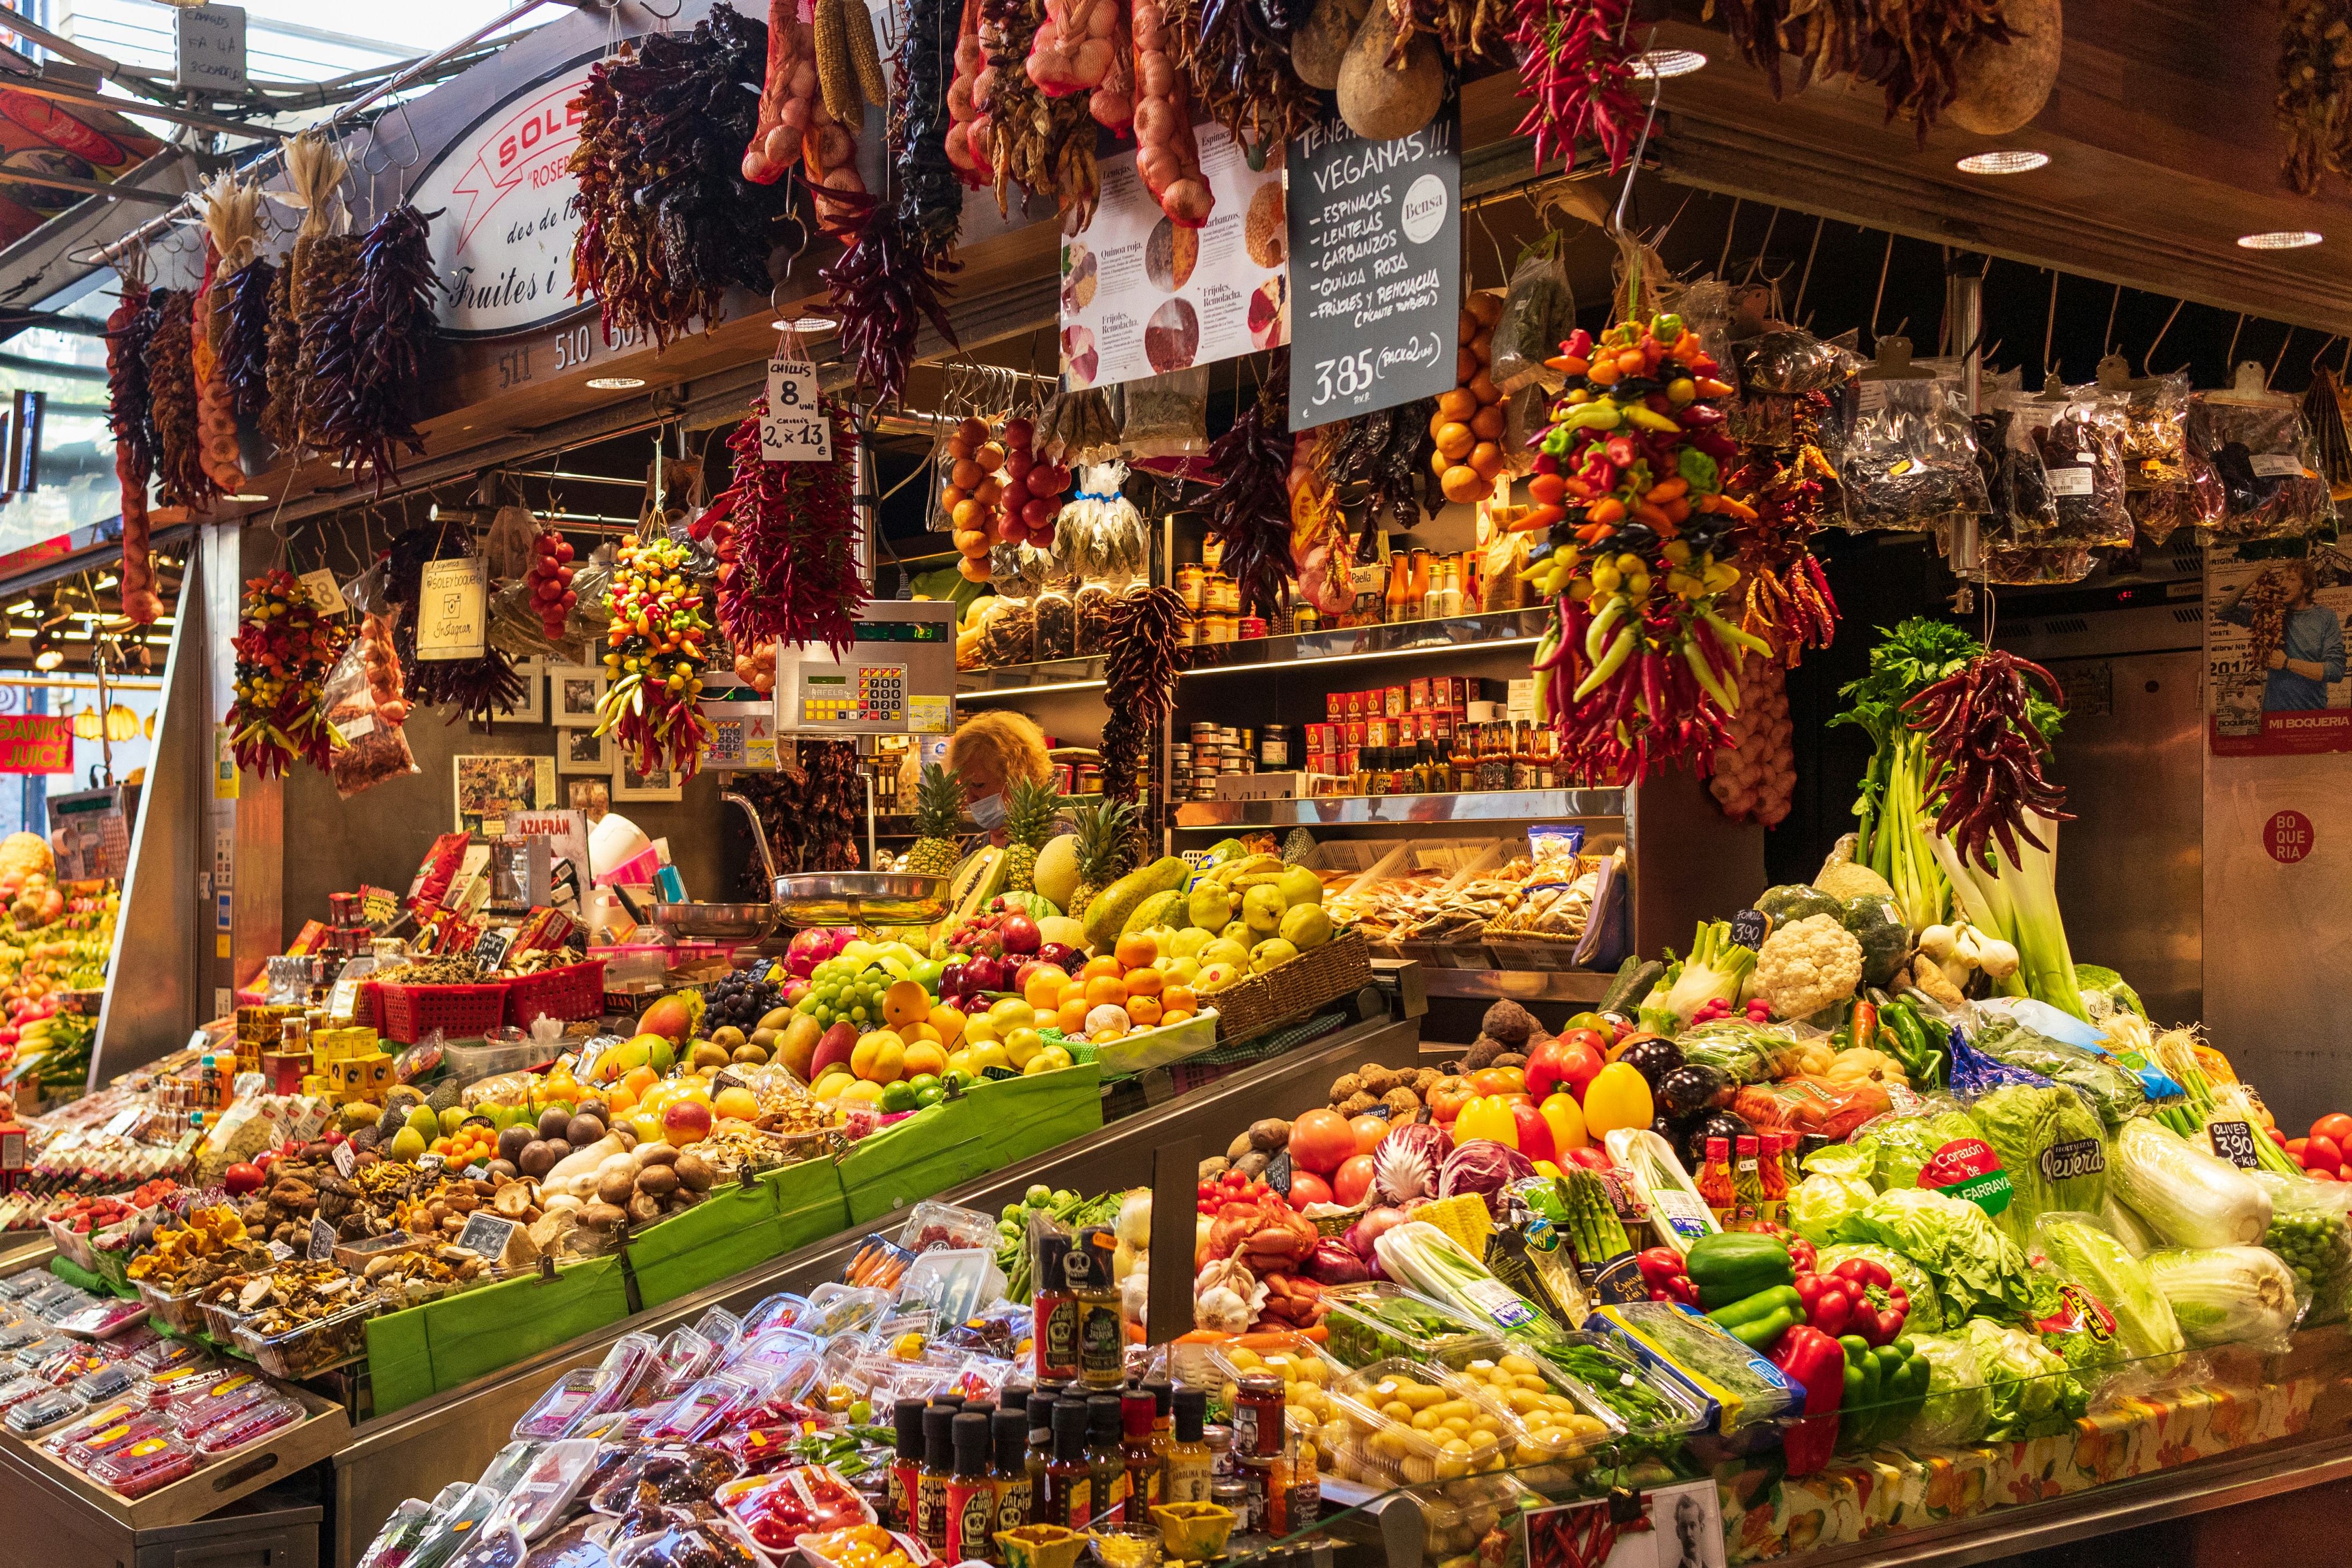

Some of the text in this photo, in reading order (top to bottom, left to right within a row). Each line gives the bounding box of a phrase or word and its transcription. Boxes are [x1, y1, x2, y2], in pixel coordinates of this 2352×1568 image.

[499, 100, 582, 168] SOLE
[1406, 195, 1443, 220] Bensa
[508, 222, 534, 245] des
[540, 210, 558, 231] de
[1323, 212, 1384, 247] LENTEJAS
[1101, 241, 1143, 260] Quinoa roja.
[1322, 229, 1397, 272] GARBANZOS
[1375, 252, 1409, 278] ROJA
[450, 264, 539, 310] Fruites
[1203, 291, 1242, 307] Remolacha.
[1102, 319, 1138, 334] Remolacha.
[498, 345, 532, 387] 511
[555, 325, 590, 370] 510
[770, 363, 811, 377] CHILLIS
[1312, 348, 1373, 406] 3.85
[781, 380, 799, 405] 8
[799, 400, 816, 410] UNI
[797, 424, 824, 445] 13
[1351, 571, 1372, 585] Paella
[317, 581, 335, 606] 8
[2320, 599, 2352, 608] SONAJES
[433, 620, 472, 643] Instagram
[2269, 716, 2350, 729] MI BOQUERIA
[4, 745, 68, 767] JUICE
[520, 815, 570, 835] AZAFRÁN
[2276, 815, 2296, 828] BO
[2276, 830, 2305, 844] QUE
[2276, 845, 2301, 859] RIA
[2214, 1123, 2247, 1135] OLIVES
[1935, 1142, 1984, 1167] Corazón
[2055, 1140, 2093, 1153] HORTALIZAS
[1967, 1165, 1981, 1178] de
[1962, 1176, 2012, 1201] FARRAYA
[880, 1317, 926, 1331] TRINIDAD SCORPION
[2071, 1295, 2106, 1338] DULZE
[858, 1359, 885, 1367] CAROLINA
[843, 1376, 866, 1394] HABANERO
[923, 1480, 943, 1489] SALSA
[1173, 1470, 1198, 1481] CAROLINA
